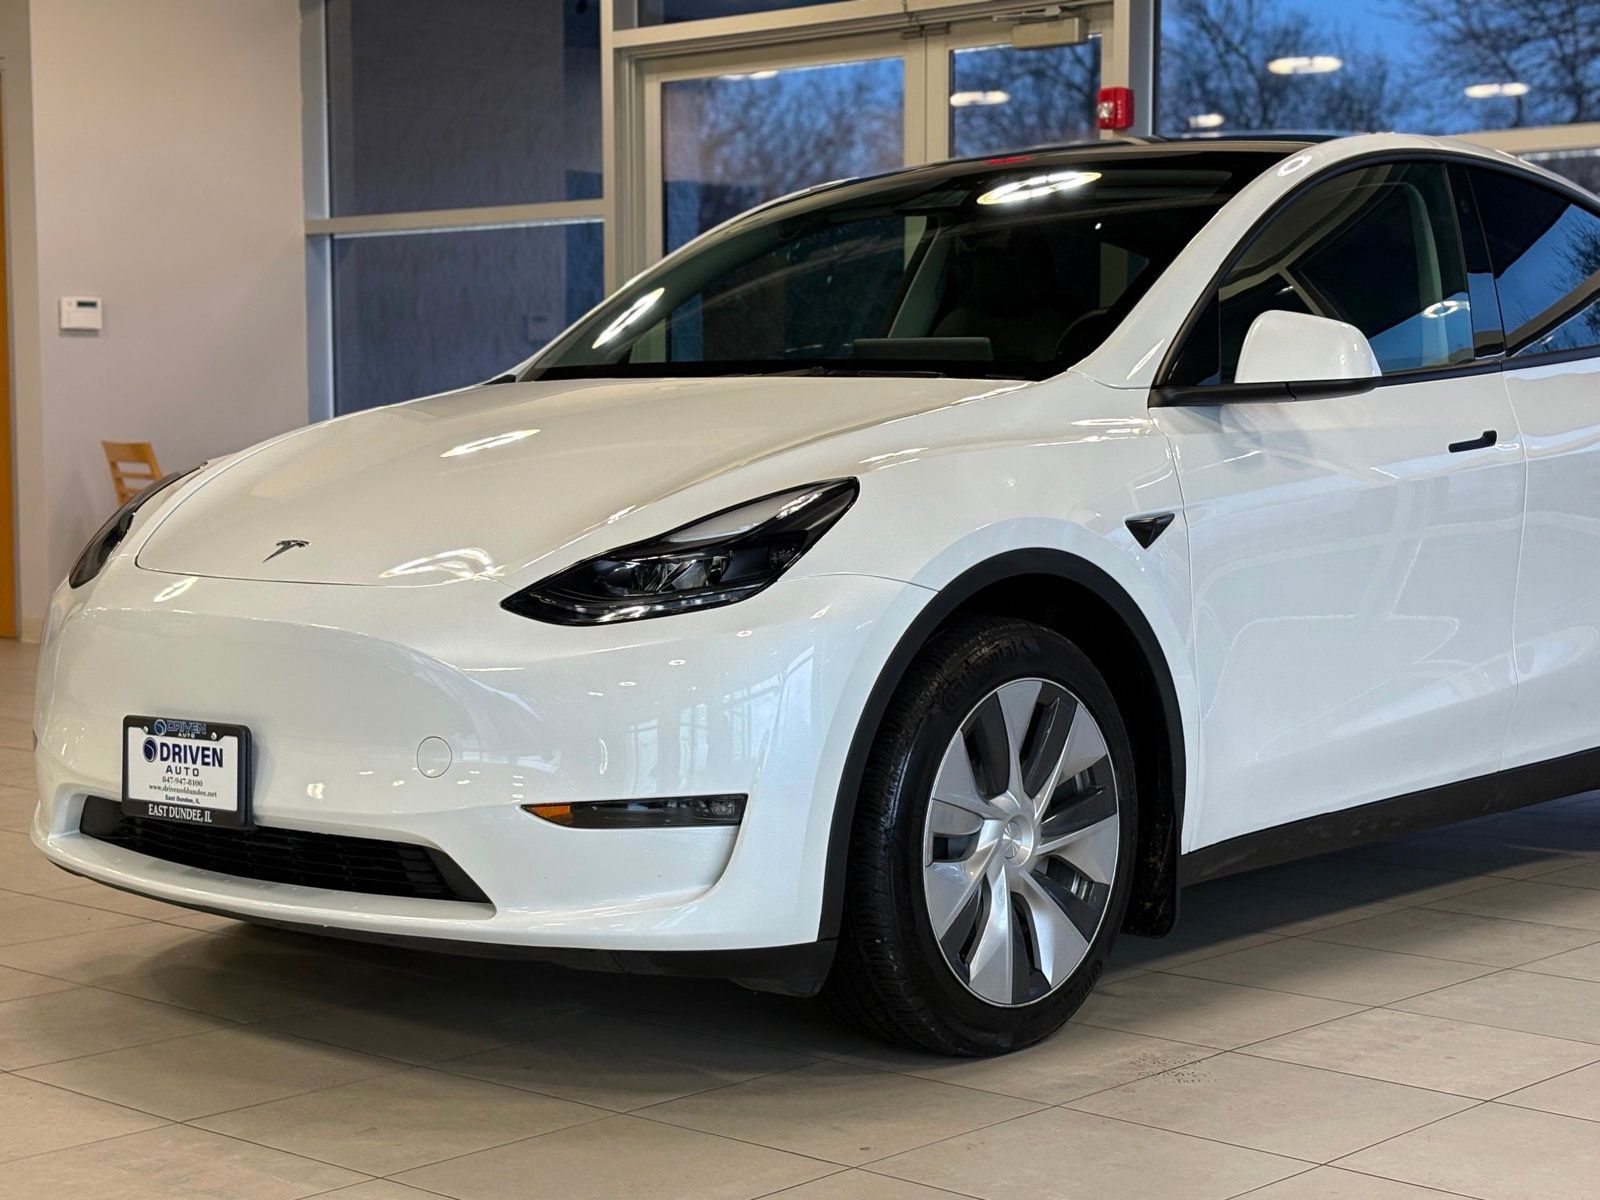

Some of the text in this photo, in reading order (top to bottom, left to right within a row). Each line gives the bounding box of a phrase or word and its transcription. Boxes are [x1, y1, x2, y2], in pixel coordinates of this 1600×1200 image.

[167, 720, 206, 735] DRIVEN
[160, 742, 223, 768] DRIVEN
[166, 765, 199, 777] AUTO
[162, 776, 203, 787] 847-947-8100
[149, 784, 217, 797] www.drivenofdundee.net
[148, 803, 212, 823] EAST DUNDEE, IL
